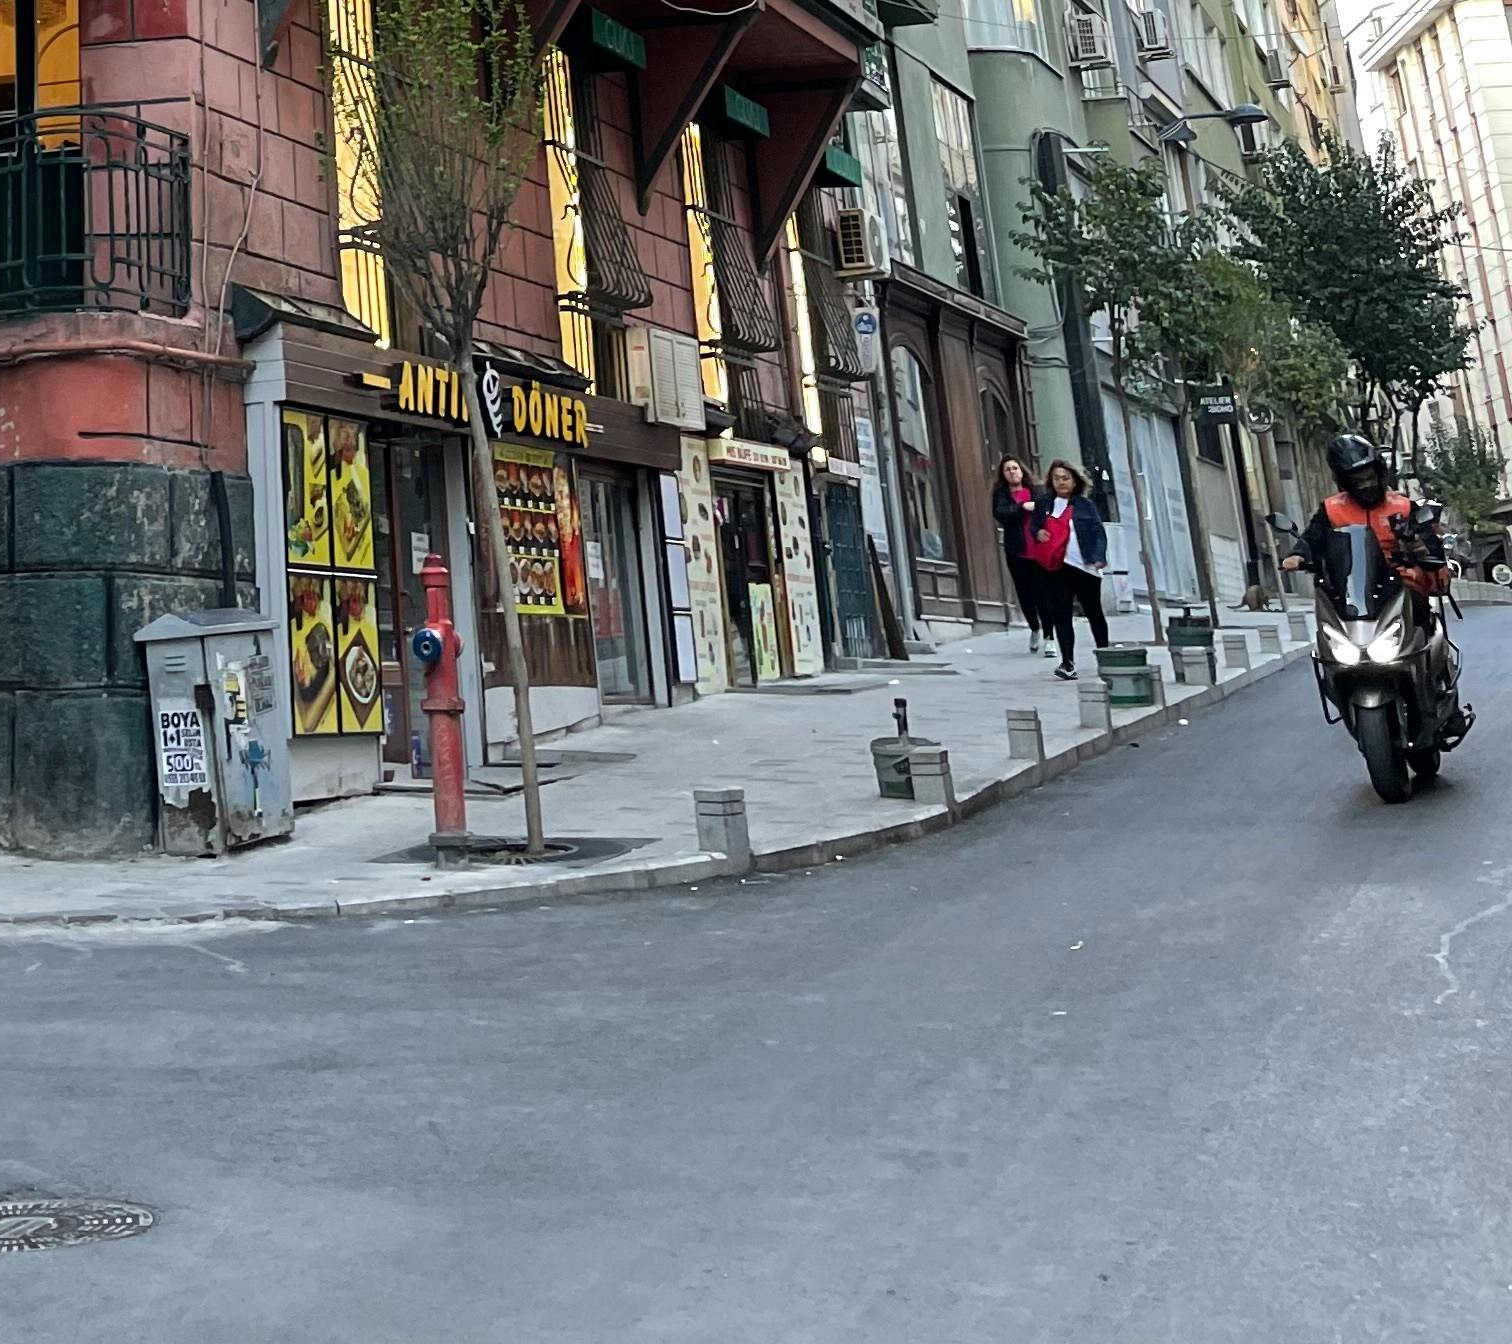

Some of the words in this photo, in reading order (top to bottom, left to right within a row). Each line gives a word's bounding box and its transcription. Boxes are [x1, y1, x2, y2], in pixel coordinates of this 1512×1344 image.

[511, 379, 589, 449] DÖNER
[161, 712, 201, 729] BOYA
[166, 753, 194, 772] 500
